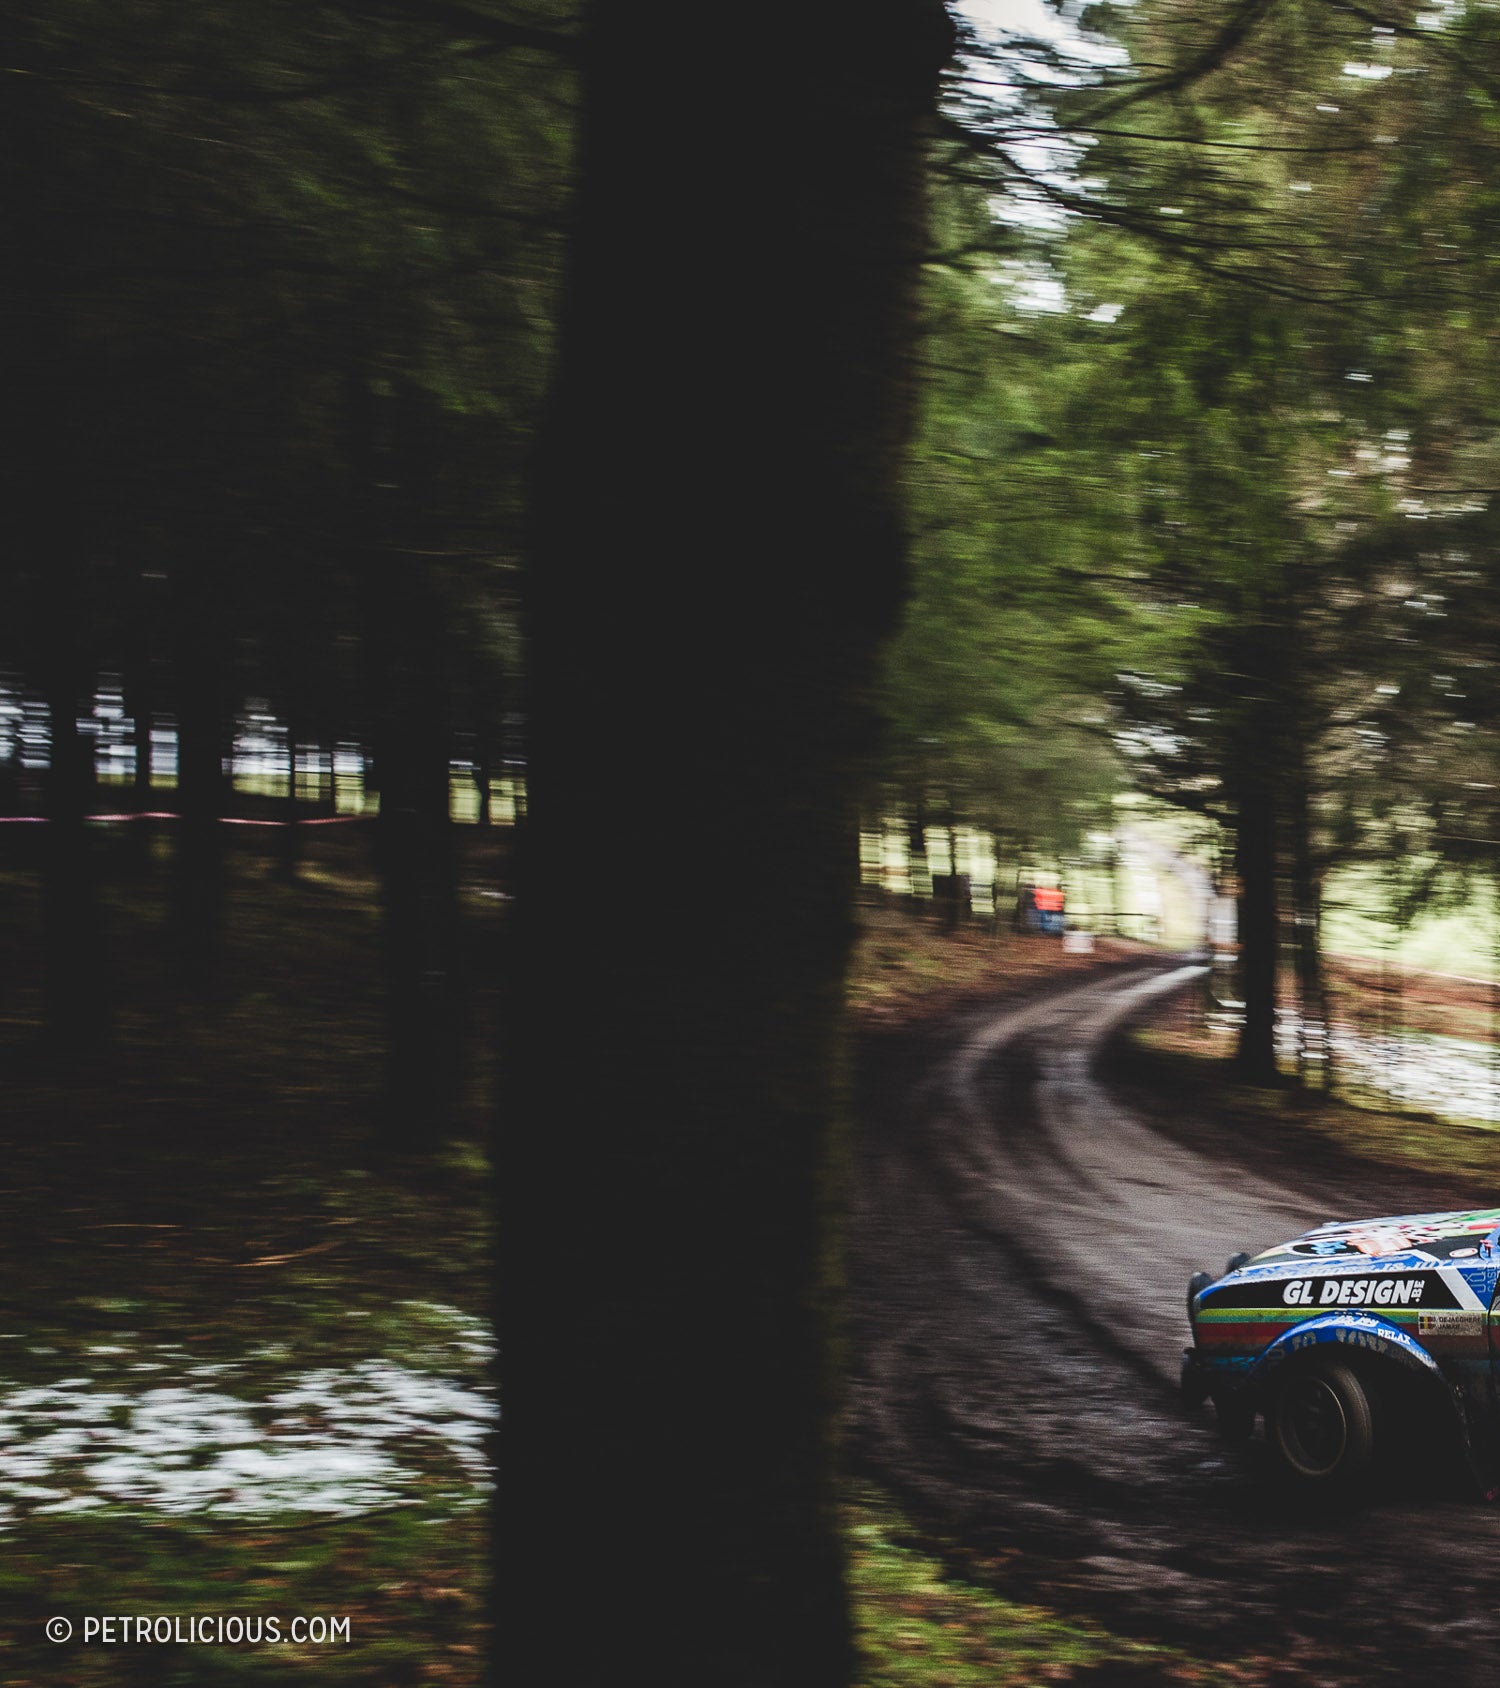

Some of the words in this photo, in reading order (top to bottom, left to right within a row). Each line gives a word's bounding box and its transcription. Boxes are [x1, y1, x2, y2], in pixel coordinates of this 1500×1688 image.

[1283, 1281, 1314, 1305] GL
[1319, 1279, 1415, 1304] DESIGN
[1377, 1328, 1411, 1346] RELAX
